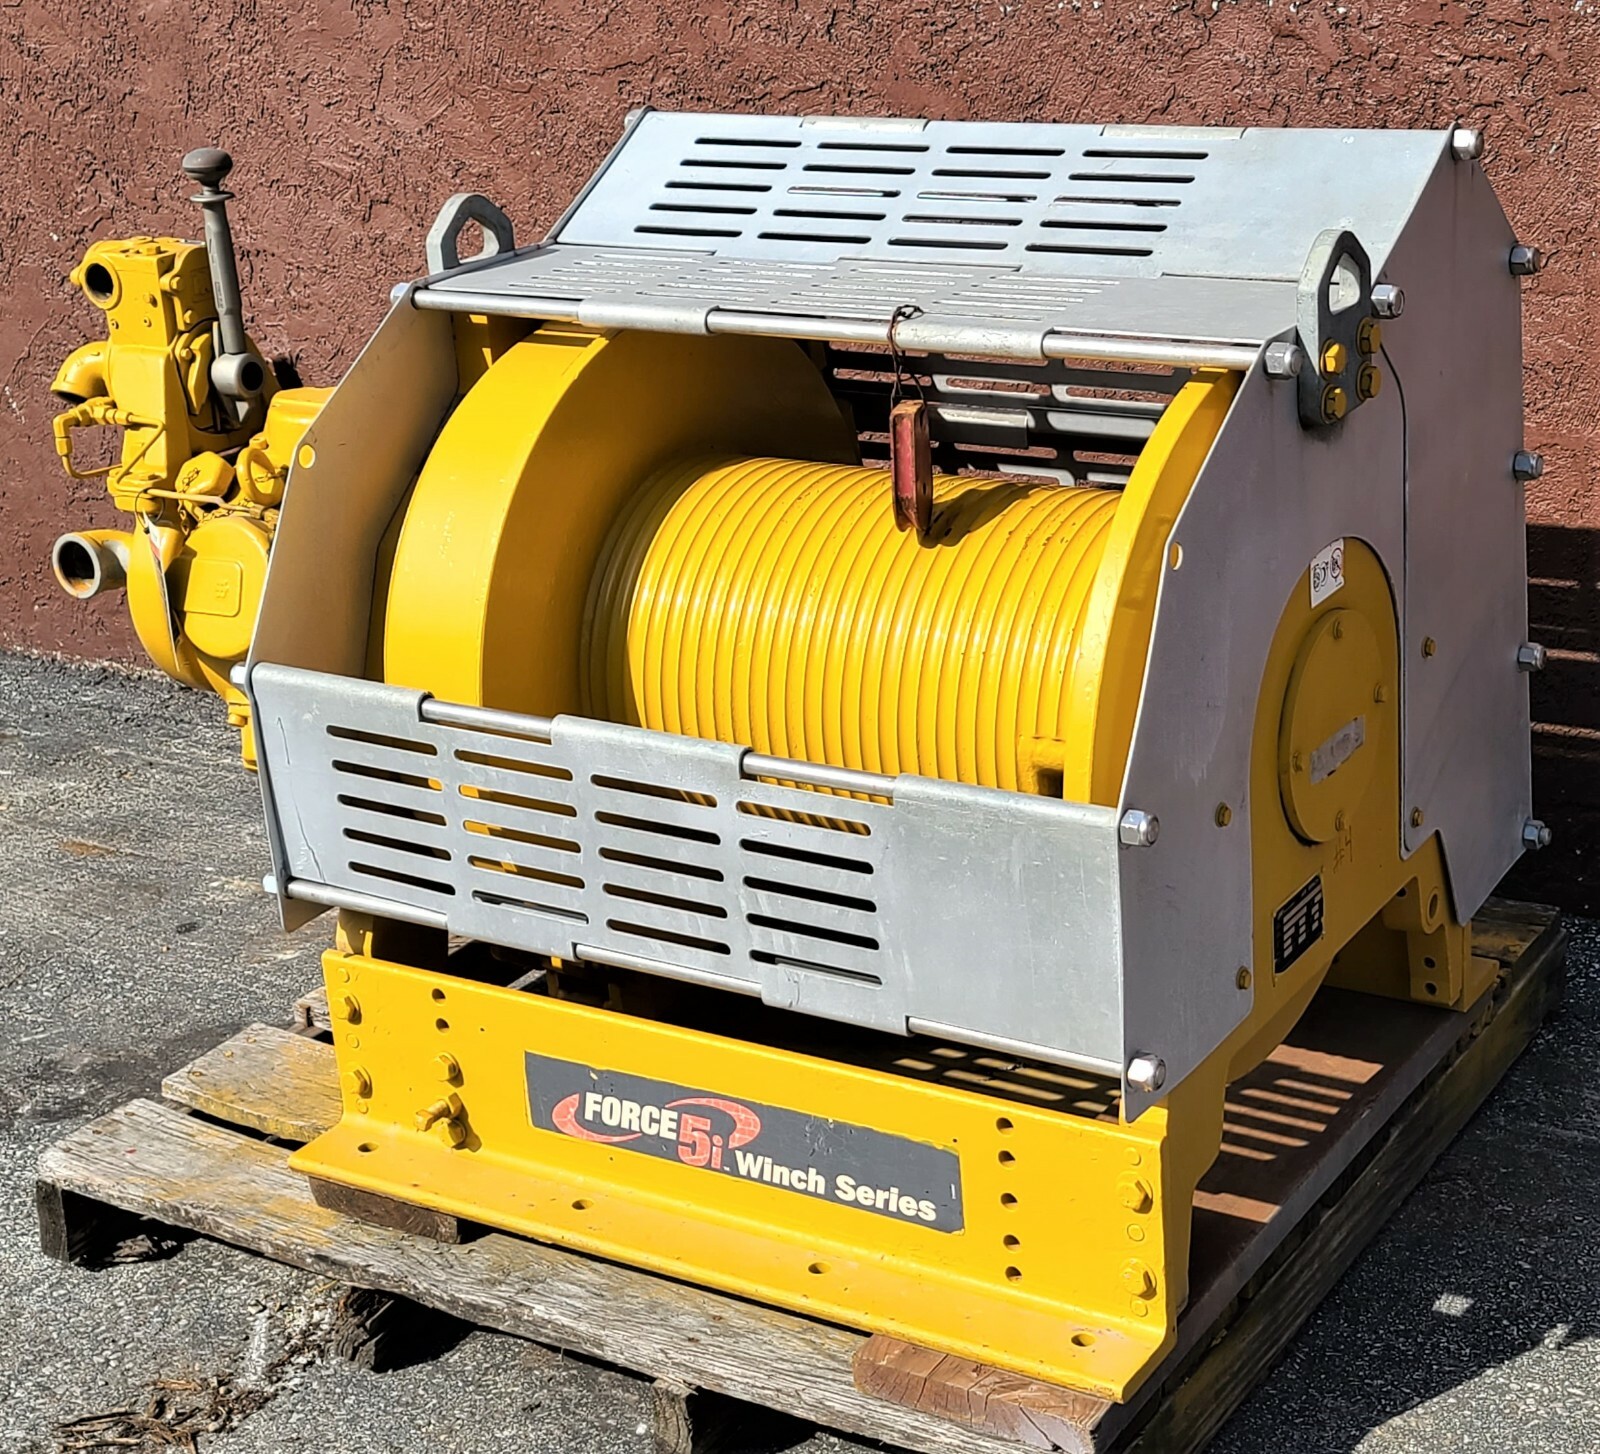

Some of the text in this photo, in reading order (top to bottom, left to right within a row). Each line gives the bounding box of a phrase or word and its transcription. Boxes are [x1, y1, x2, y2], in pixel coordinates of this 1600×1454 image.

[584, 1091, 678, 1141] FORCE
[734, 1149, 826, 1195] Winch
[834, 1174, 938, 1222] Series
